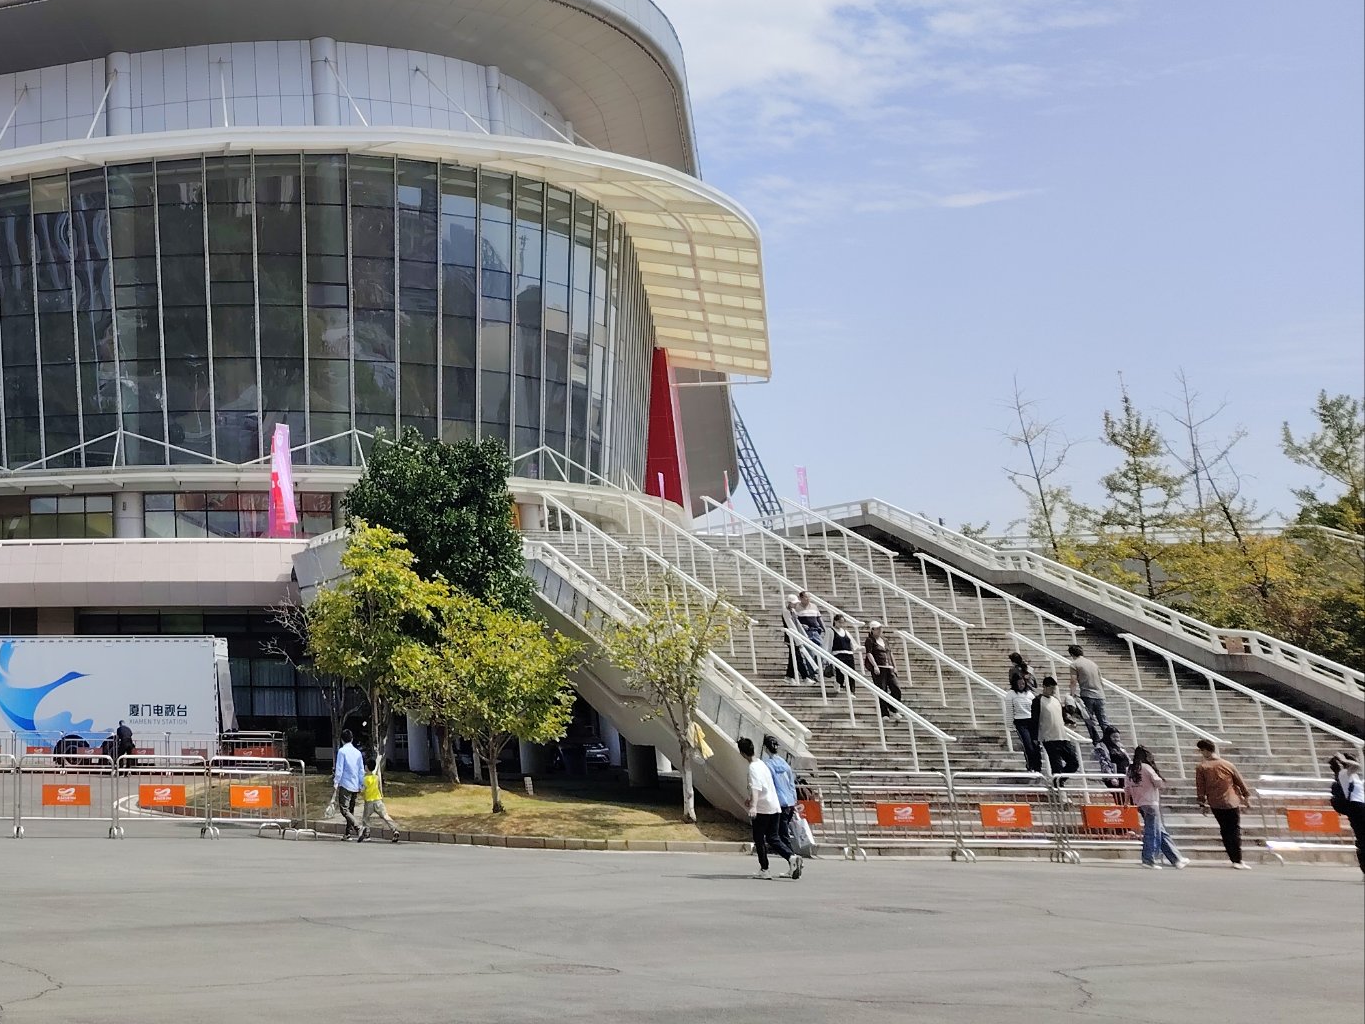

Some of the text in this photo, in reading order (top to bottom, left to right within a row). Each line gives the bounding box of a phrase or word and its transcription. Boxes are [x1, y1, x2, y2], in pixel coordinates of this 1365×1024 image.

[129, 704, 187, 717] 厦门电视台
